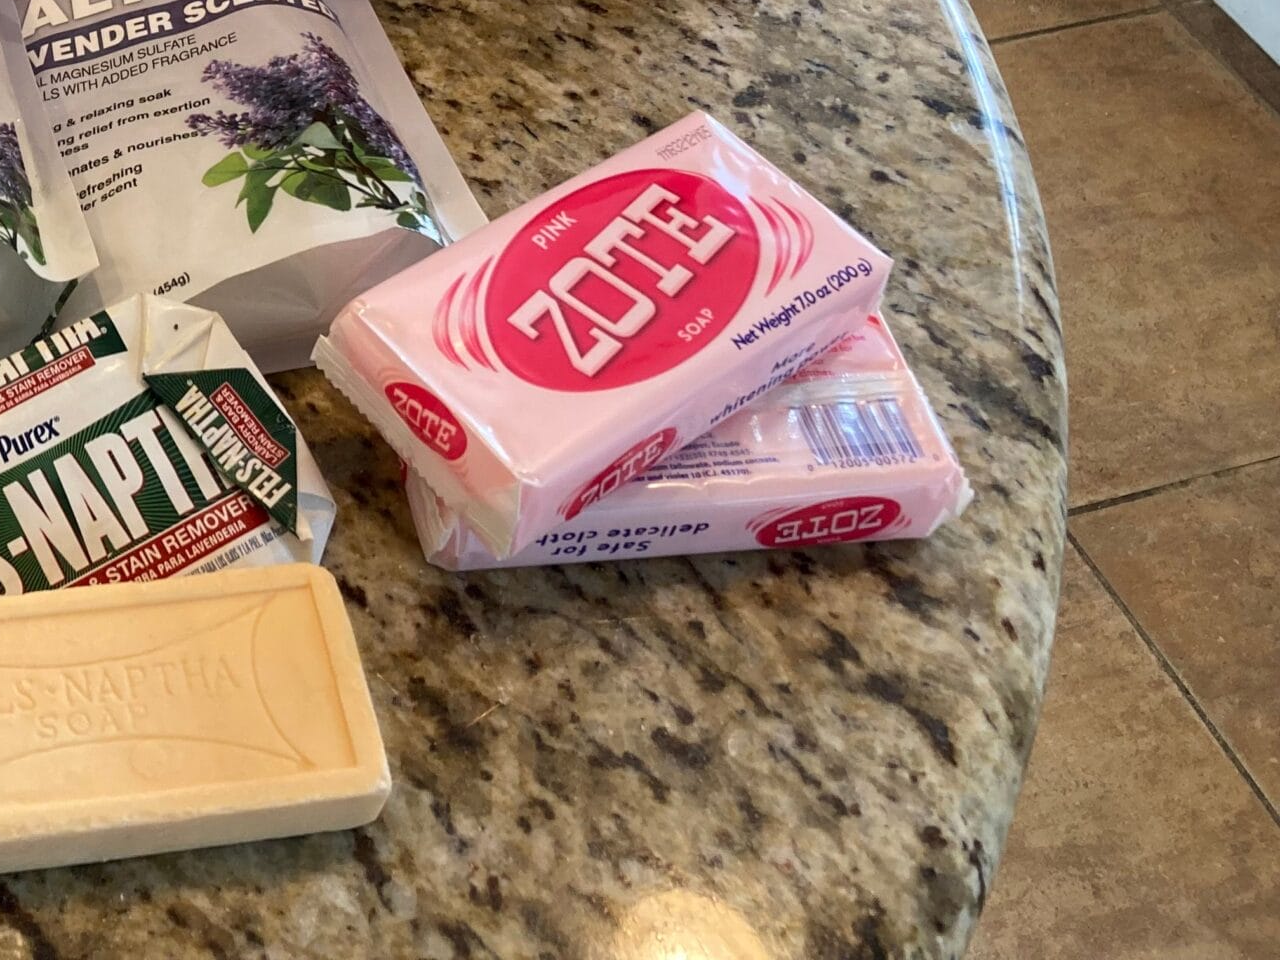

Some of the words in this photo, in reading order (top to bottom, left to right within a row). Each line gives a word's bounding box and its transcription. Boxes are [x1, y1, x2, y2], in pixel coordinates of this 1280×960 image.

[50, 51, 135, 84] MAGNESIUM
[136, 34, 197, 60] SULFATE
[80, 97, 135, 123] relaxing
[139, 87, 173, 105] soak
[531, 210, 578, 250] PINK
[153, 270, 191, 297] (454g)
[506, 182, 738, 378] ZOTE
[730, 329, 758, 351] Net
[753, 303, 801, 335] Weight
[795, 290, 818, 311] 7.0
[816, 284, 833, 300] oz
[827, 265, 860, 292] (200
[856, 257, 874, 277] g)
[676, 307, 715, 343] SOAP
[5, 377, 37, 399] STAIN
[35, 350, 89, 382] REMOVER
[770, 342, 816, 374] More
[710, 362, 796, 426] whitening
[392, 387, 458, 452] ZOTE
[174, 383, 293, 510] FELS-NAPTHA
[105, 545, 163, 584] STAIN
[161, 494, 255, 555] REMOVER
[535, 528, 597, 546] cloth
[606, 521, 711, 538] delicate
[775, 504, 885, 544] ZOTE
[551, 542, 587, 556] for
[596, 540, 652, 553] Safe
[36, 701, 150, 741] SOAP
